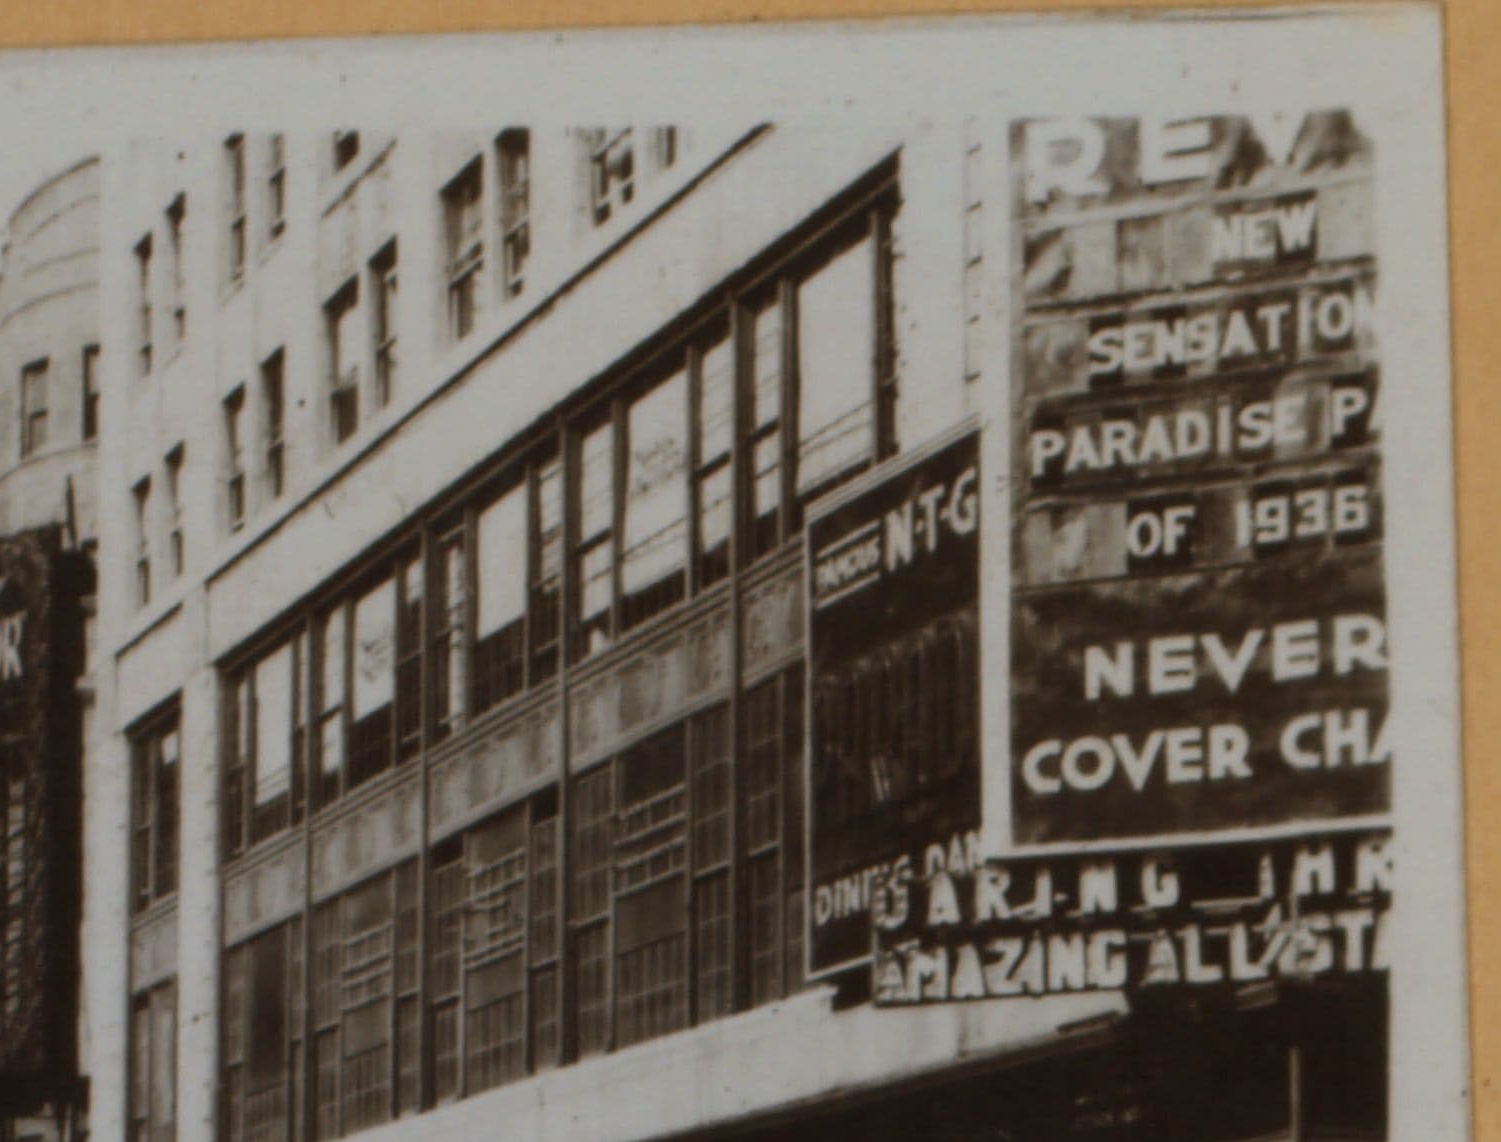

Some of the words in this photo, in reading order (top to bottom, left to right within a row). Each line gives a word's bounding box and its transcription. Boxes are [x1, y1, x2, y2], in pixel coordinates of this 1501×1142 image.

[1210, 200, 1315, 259] NEW
[1031, 396, 1303, 475] PARADISE
[1329, 387, 1381, 438] P
[1125, 505, 1196, 556] OF
[1234, 484, 1367, 549] 1936
[1084, 612, 1389, 700] NEVER
[1021, 722, 1256, 795] COVER
[875, 928, 1128, 1001] AMAZING
